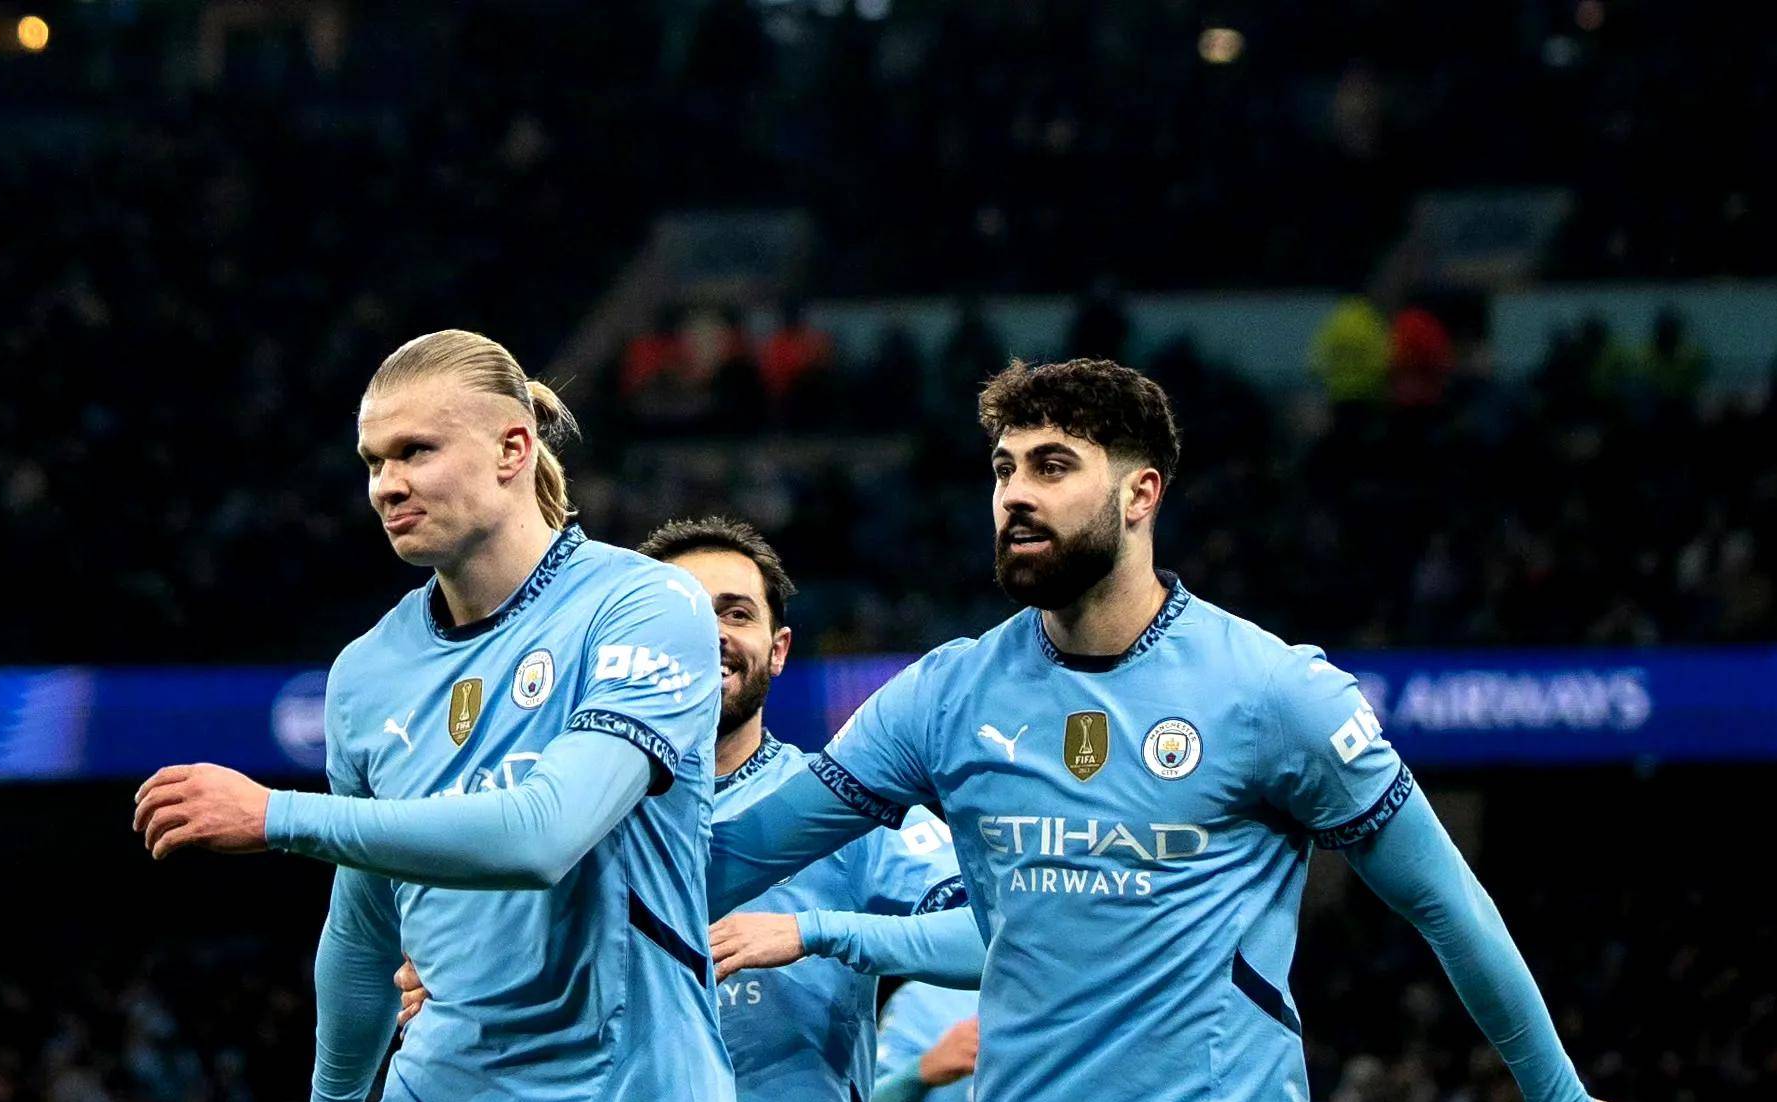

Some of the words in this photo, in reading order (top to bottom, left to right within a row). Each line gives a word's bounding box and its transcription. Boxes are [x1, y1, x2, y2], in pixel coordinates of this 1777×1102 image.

[1074, 754, 1096, 765] FIFA
[978, 815, 1209, 861] ETIHAD
[1009, 867, 1153, 896] AIRWAYS
